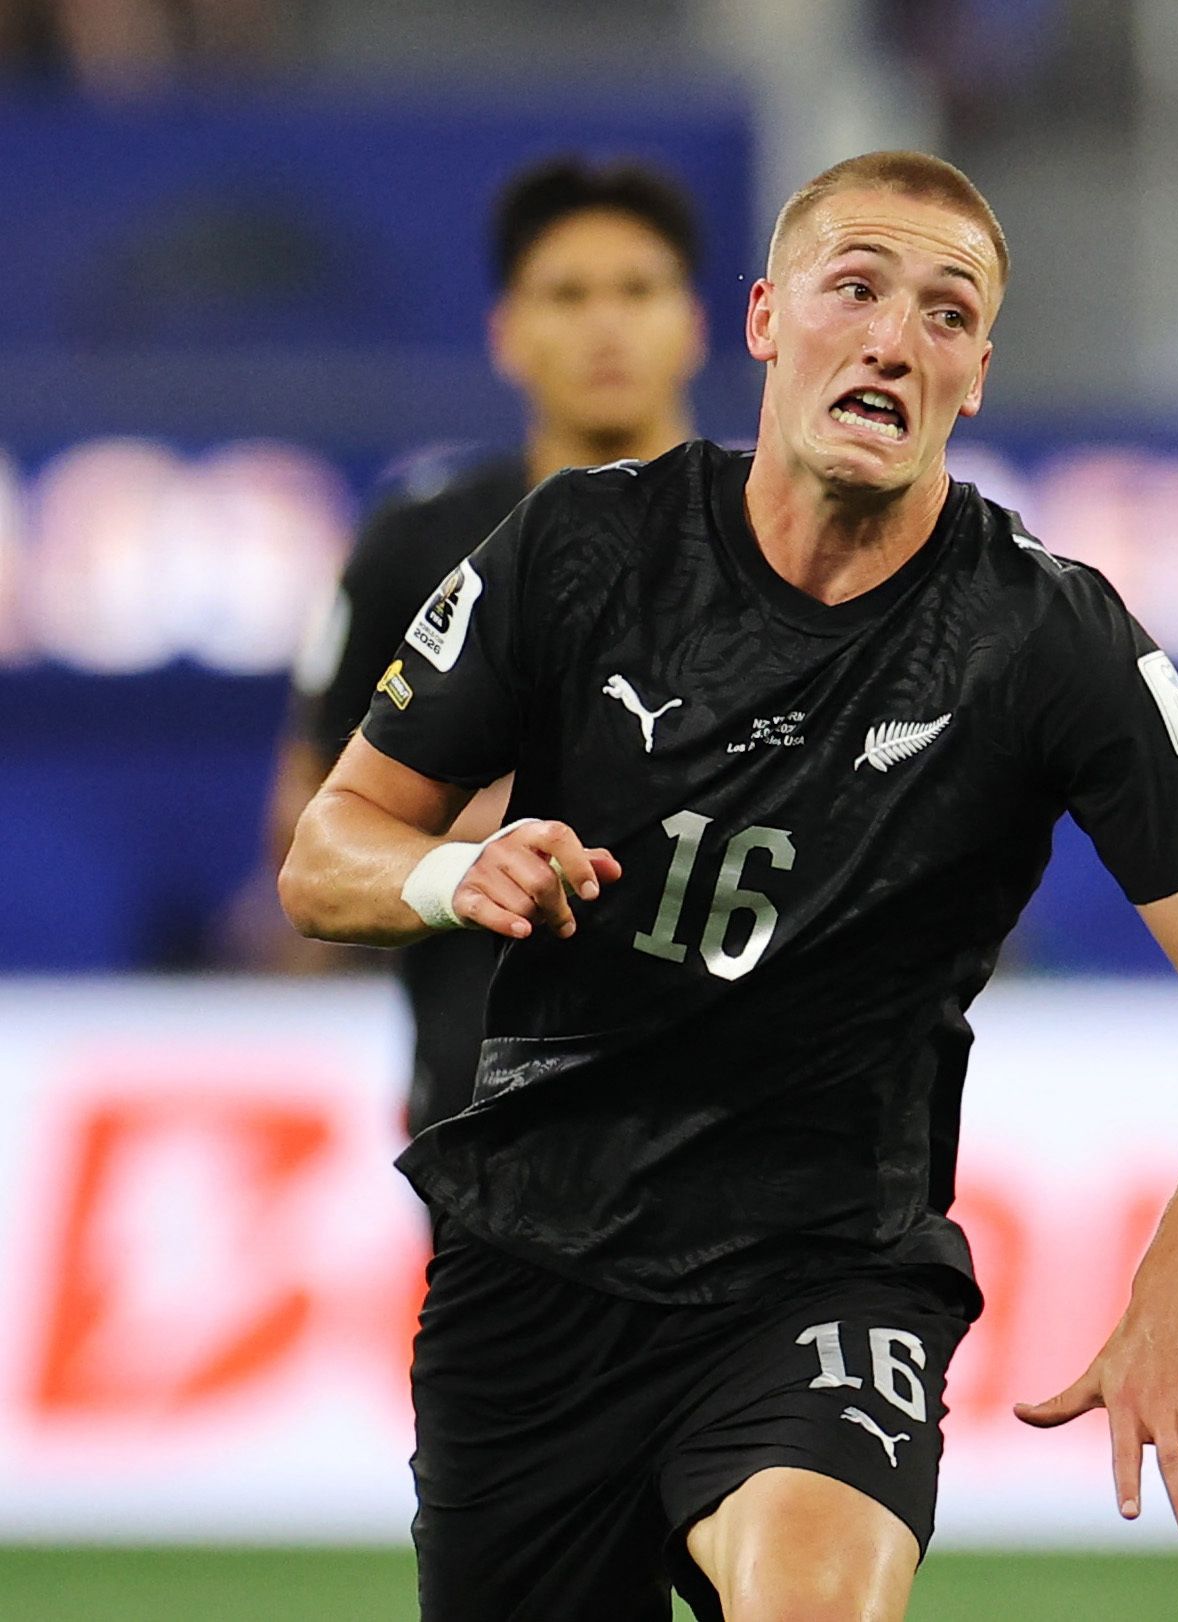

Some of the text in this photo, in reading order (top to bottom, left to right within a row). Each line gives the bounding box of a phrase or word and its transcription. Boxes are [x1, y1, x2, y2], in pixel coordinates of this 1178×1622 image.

[414, 628, 441, 655] 2026
[727, 742, 747, 754] Los
[633, 810, 796, 982] 16
[796, 1320, 927, 1423] 16
